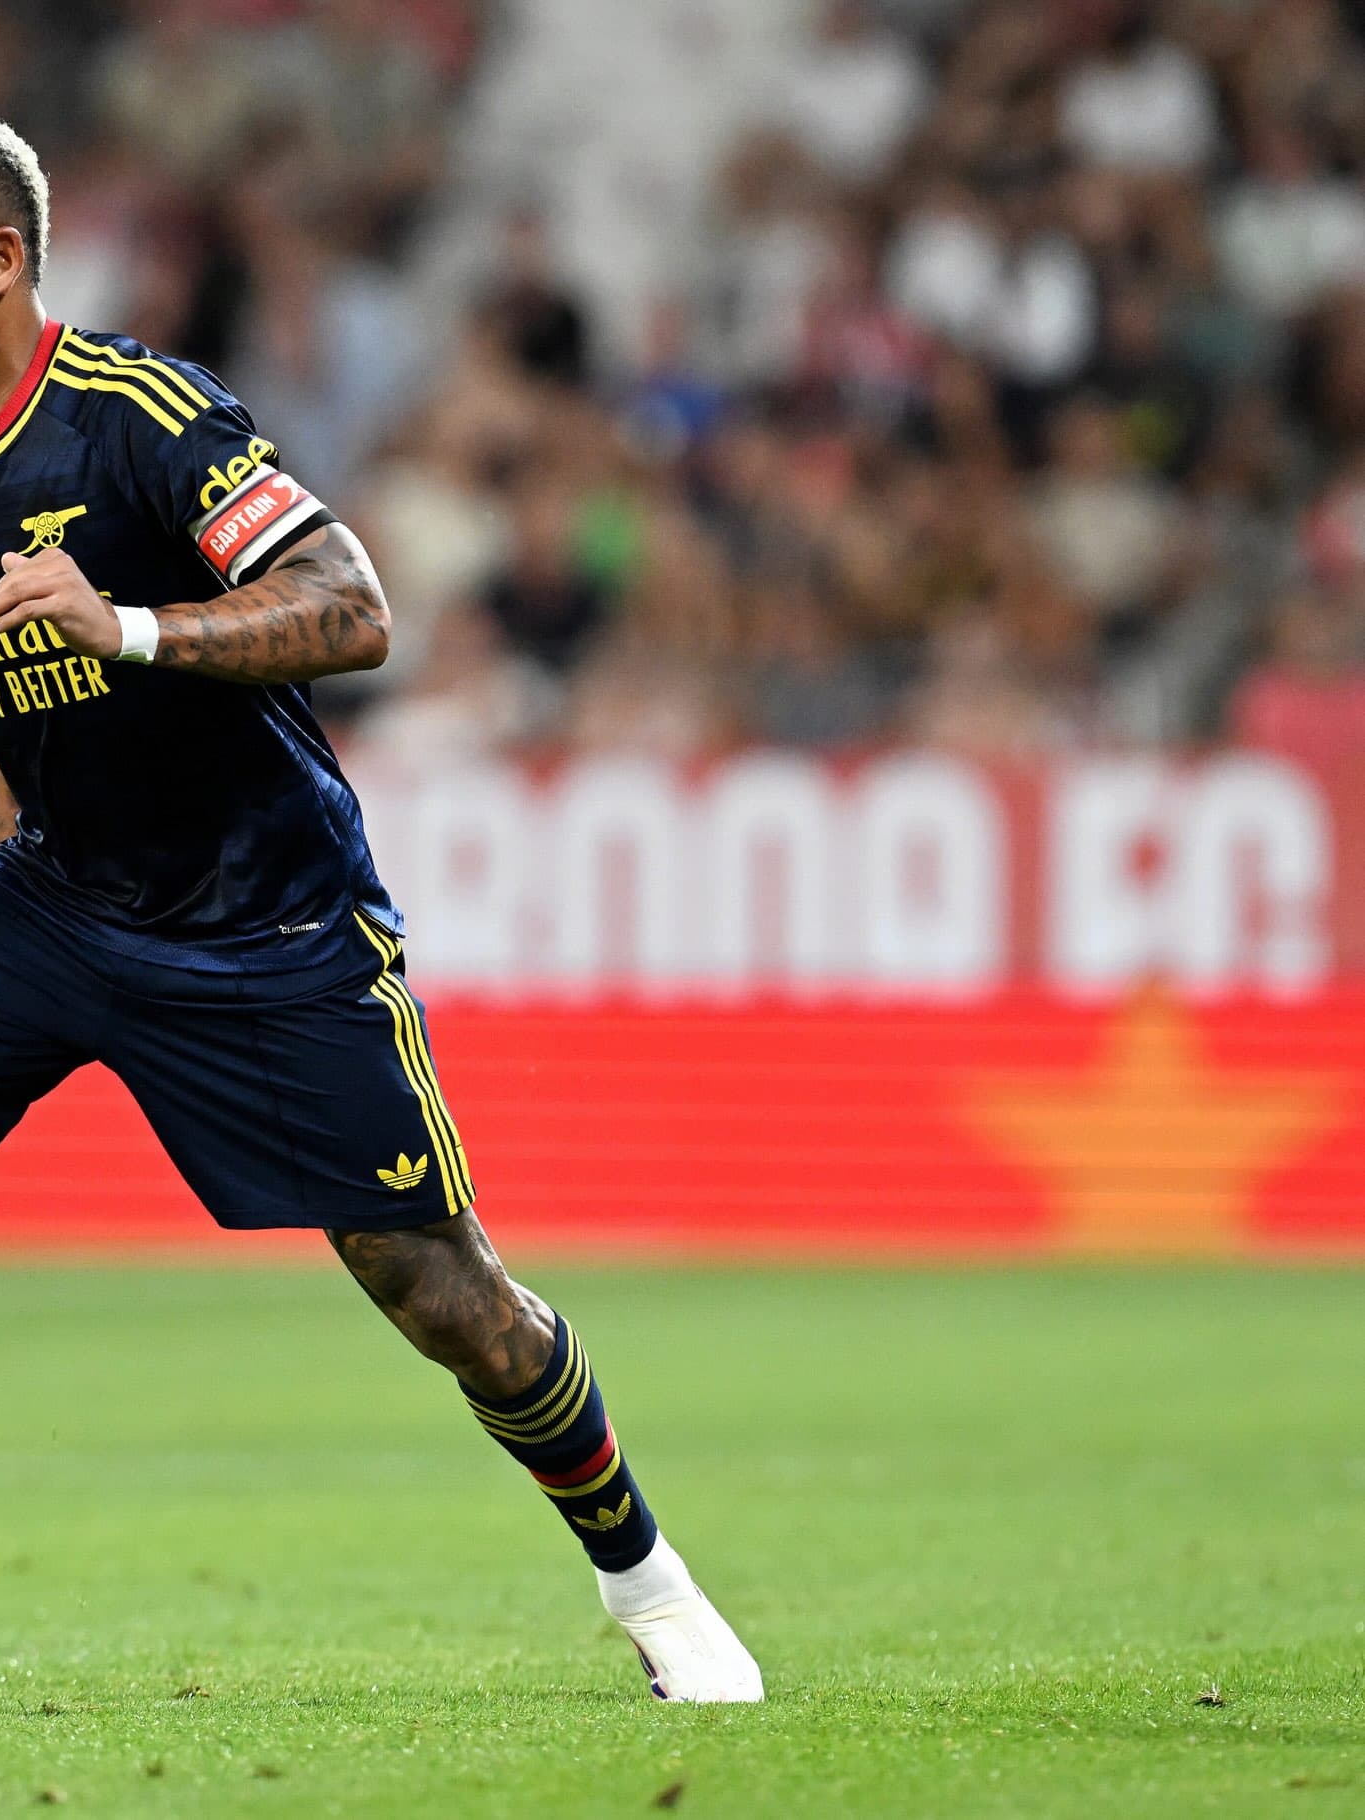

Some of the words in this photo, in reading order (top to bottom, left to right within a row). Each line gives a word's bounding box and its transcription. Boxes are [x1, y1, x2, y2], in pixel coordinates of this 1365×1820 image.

[200, 437, 278, 510] dee
[209, 492, 278, 555] CAPTAIN
[4, 656, 111, 714] BETTER
